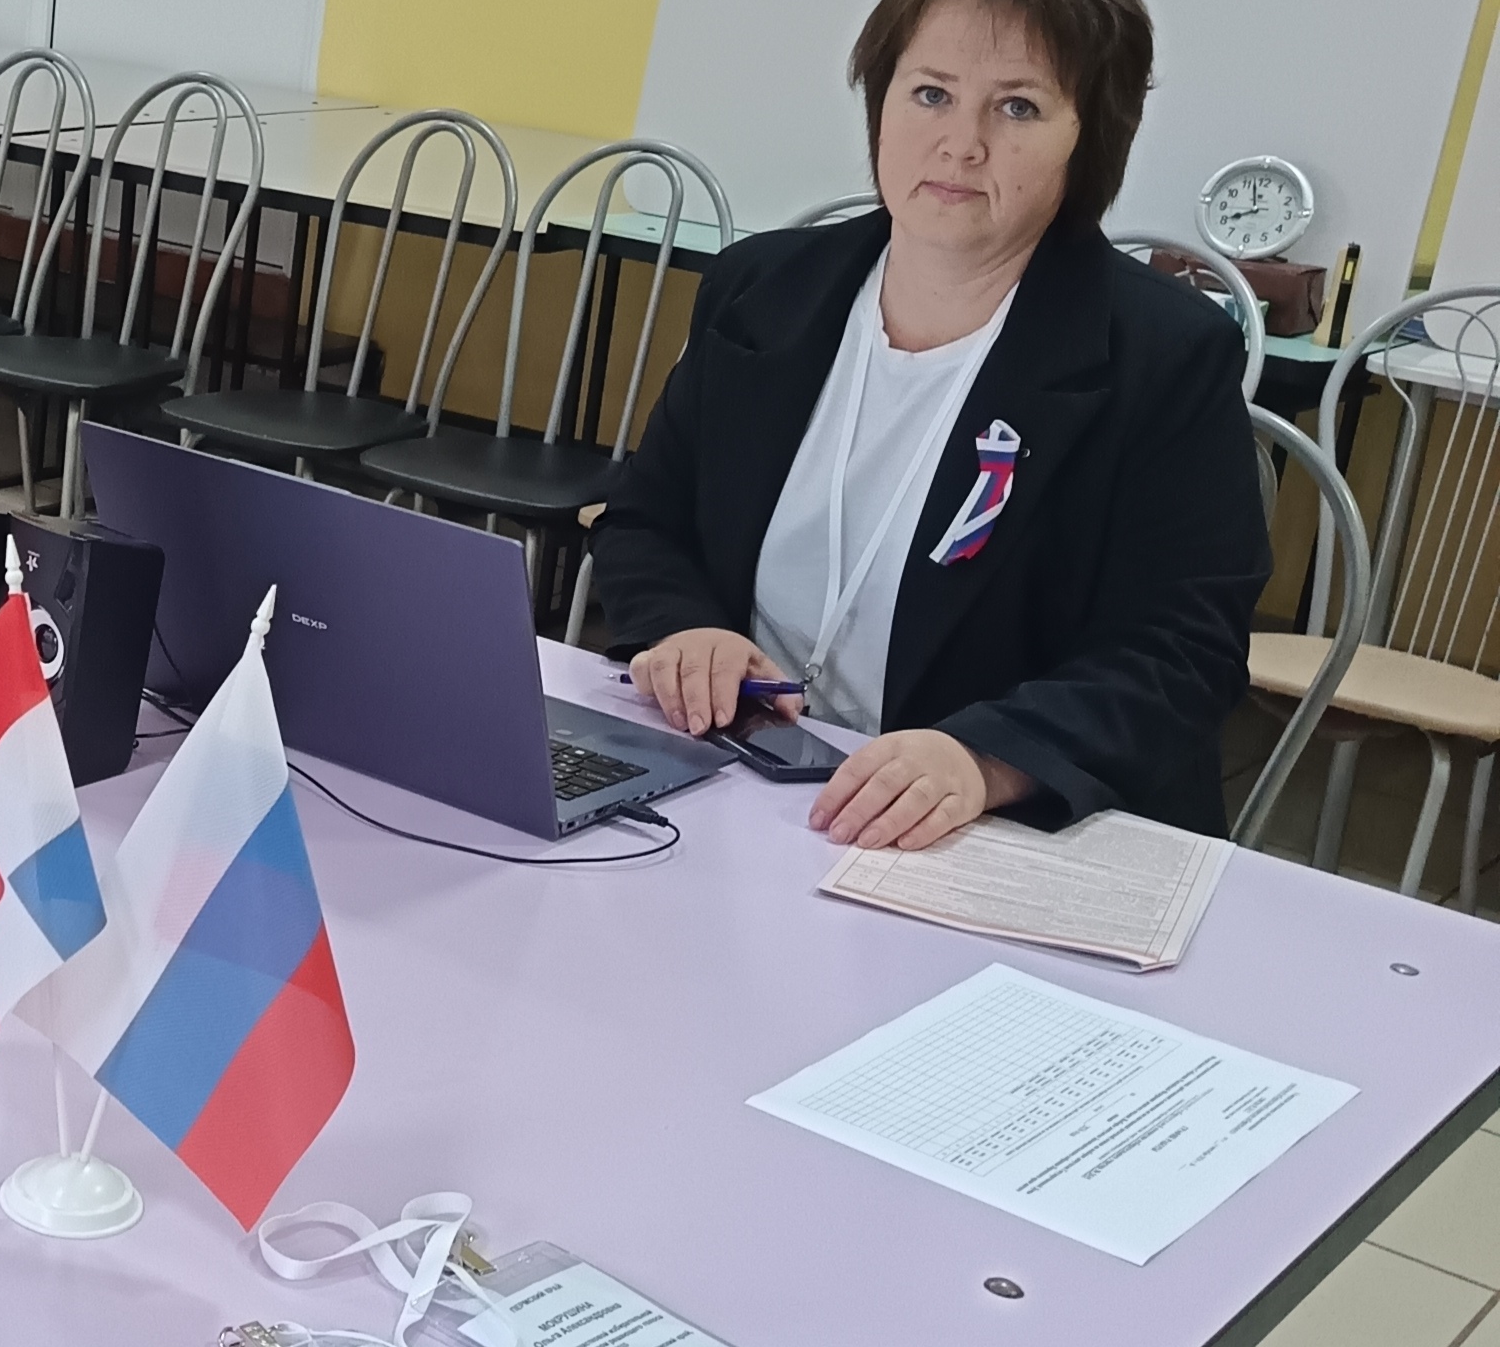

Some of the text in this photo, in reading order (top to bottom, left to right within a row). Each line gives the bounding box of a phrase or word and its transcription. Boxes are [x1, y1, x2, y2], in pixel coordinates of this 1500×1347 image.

[1242, 179, 1252, 190] 11
[1259, 178, 1272, 189] 12
[1277, 183, 1284, 194] 1
[1228, 188, 1239, 198] 10
[1219, 201, 1228, 211] 9
[1283, 196, 1293, 207] 2
[1219, 215, 1229, 225] 8
[1283, 211, 1293, 221] 3
[1227, 227, 1236, 238] 7
[1275, 224, 1283, 233] 4
[1242, 233, 1251, 244] 6
[1259, 232, 1268, 243] 5
[291, 613, 328, 630] DEXP
[538, 1301, 594, 1332] МОКРУШИНА
